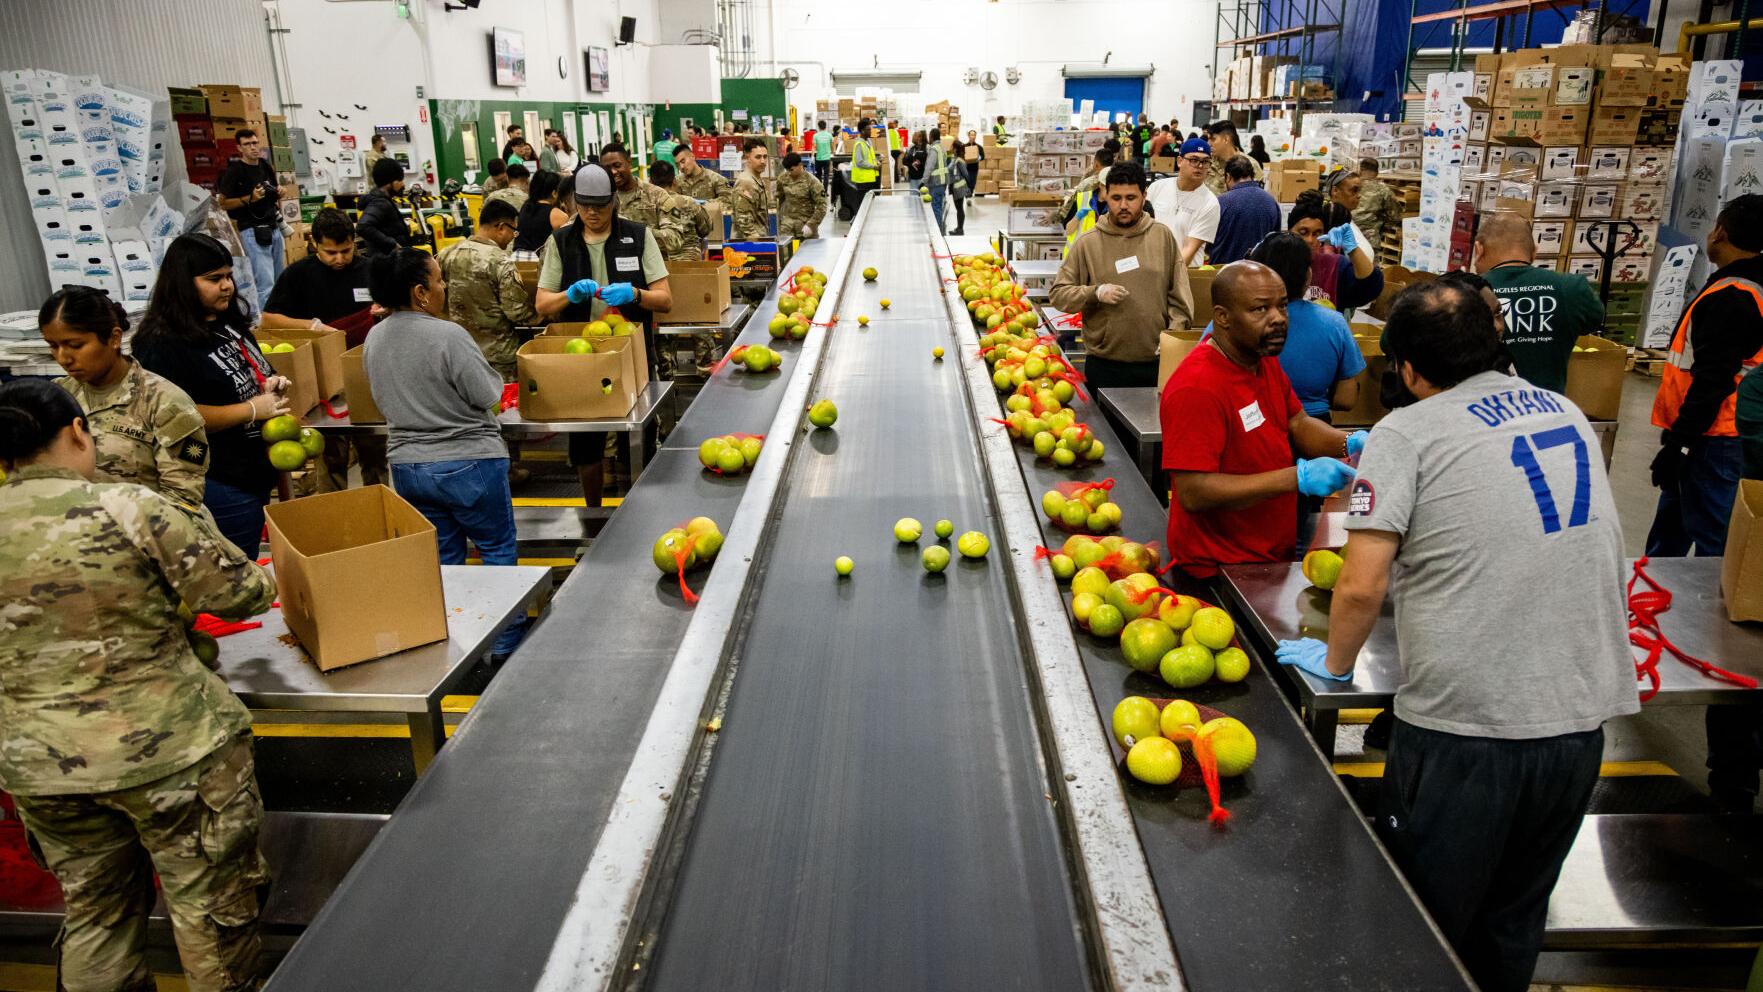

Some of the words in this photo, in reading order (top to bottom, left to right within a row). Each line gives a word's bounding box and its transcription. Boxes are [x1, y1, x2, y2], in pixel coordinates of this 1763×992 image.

[1494, 286, 1518, 294] NGELES
[1519, 284, 1555, 293] REGIONAL
[1467, 389, 1564, 427] OHTANI
[124, 428, 145, 439] ARMY
[1510, 424, 1591, 534] 17
